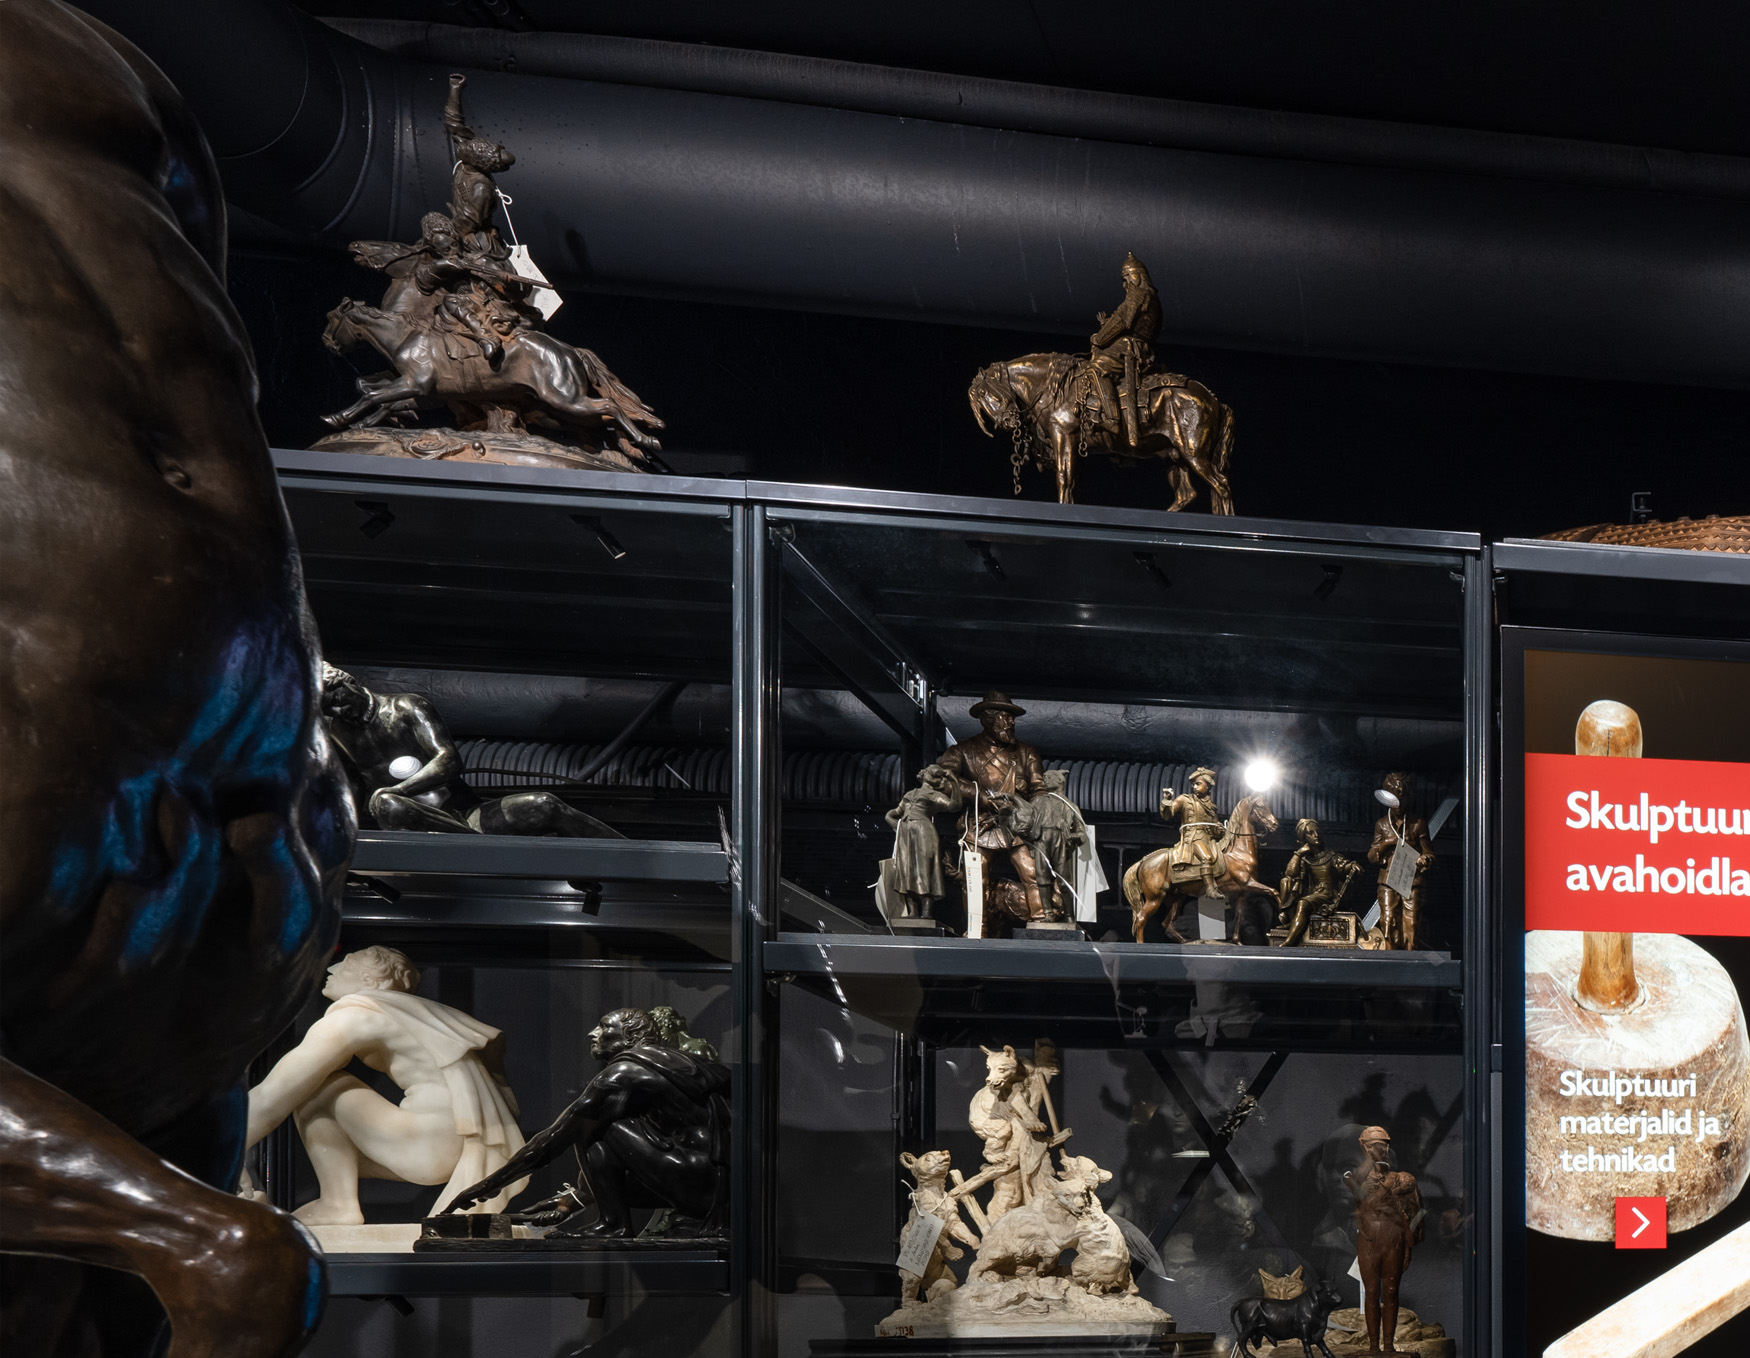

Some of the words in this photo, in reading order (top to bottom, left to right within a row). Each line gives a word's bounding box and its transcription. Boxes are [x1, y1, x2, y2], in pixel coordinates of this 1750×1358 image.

[1559, 1070, 1697, 1105] Skulptuuri
[1559, 1108, 1693, 1143] materjalid
[1694, 1110, 1721, 1143] ja
[1559, 1146, 1676, 1173] tehnikad
